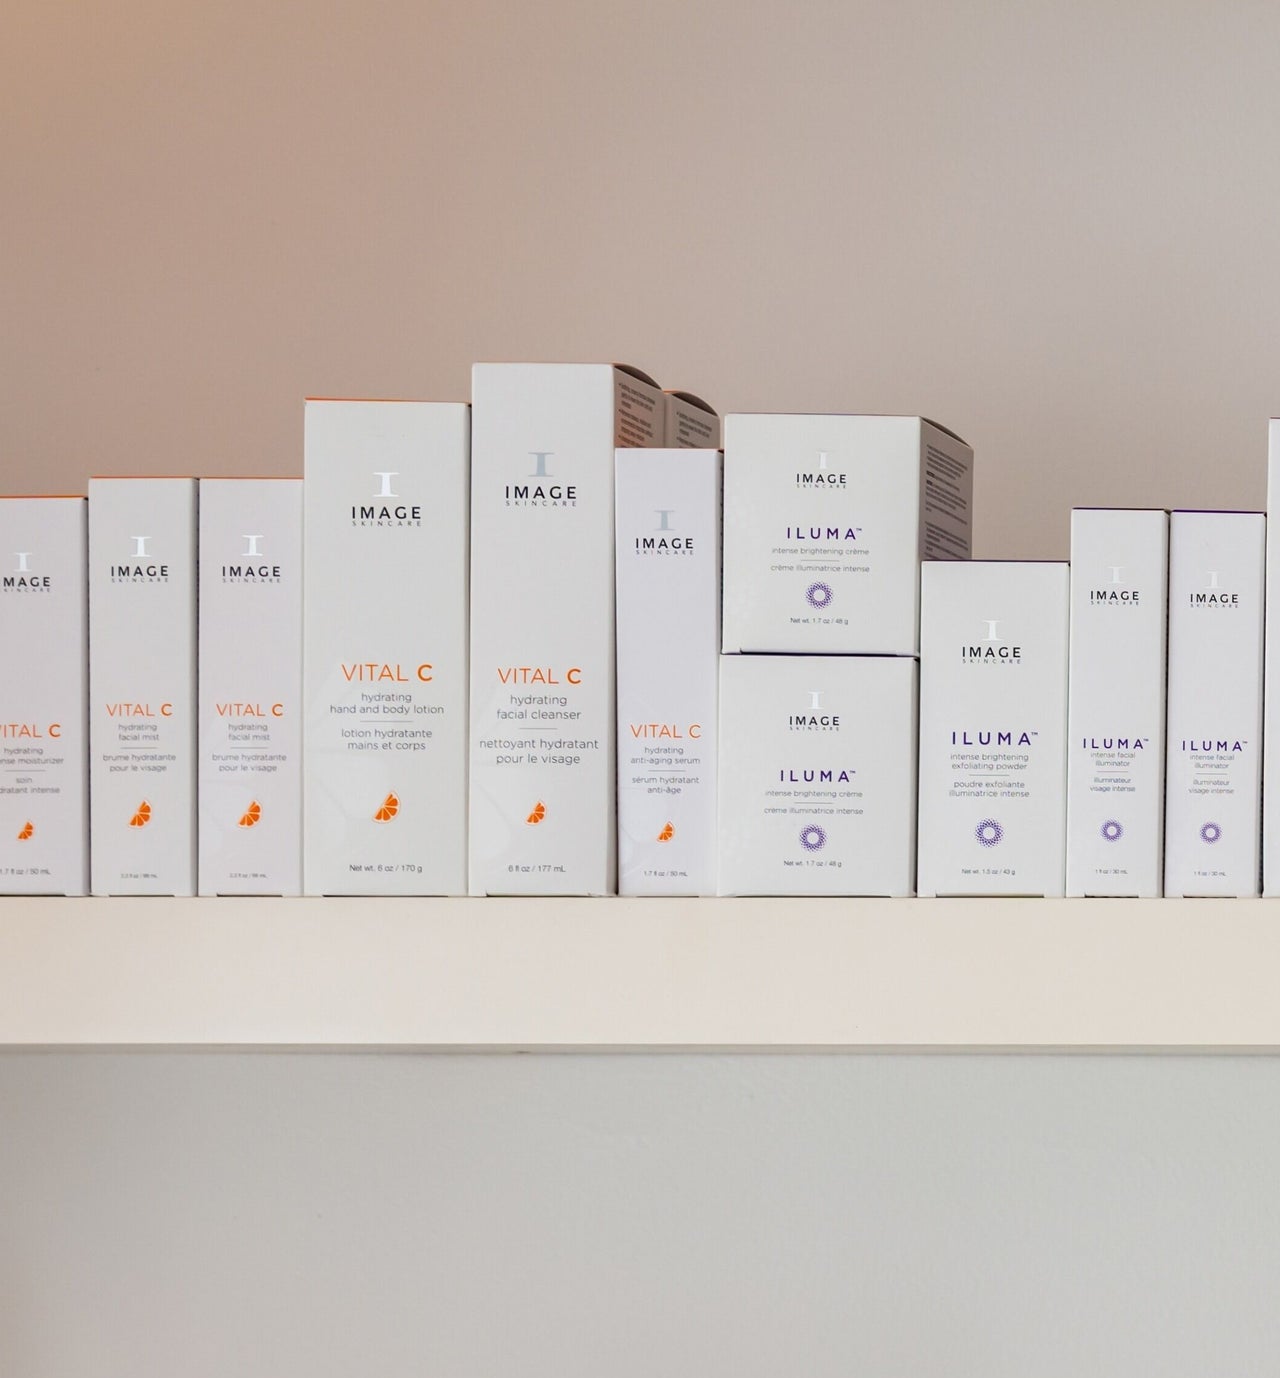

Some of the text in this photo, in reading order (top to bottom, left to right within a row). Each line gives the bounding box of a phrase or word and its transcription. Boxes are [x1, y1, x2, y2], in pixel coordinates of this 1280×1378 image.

[797, 474, 846, 483] IMAGE
[506, 486, 576, 499] IMAGE
[353, 507, 420, 519] IMAGE
[636, 538, 693, 549] IMAGE
[342, 664, 432, 681] VITAL C
[498, 668, 581, 684] VITAL C
[362, 693, 412, 704] hydrating
[511, 695, 567, 706] hydrating
[330, 705, 356, 713] hand
[383, 703, 410, 715] body
[414, 705, 444, 714] lotion
[497, 709, 581, 719] facial cleanser
[342, 729, 432, 739] lotion hydratante
[631, 725, 701, 738] VITAL C
[382, 742, 392, 750] et
[396, 741, 426, 751] corps
[480, 739, 598, 750] nettoyant hydratant
[645, 747, 683, 757] hydrating
[496, 754, 580, 765] pour le visage
[952, 761, 1027, 770] exfoliating powder
